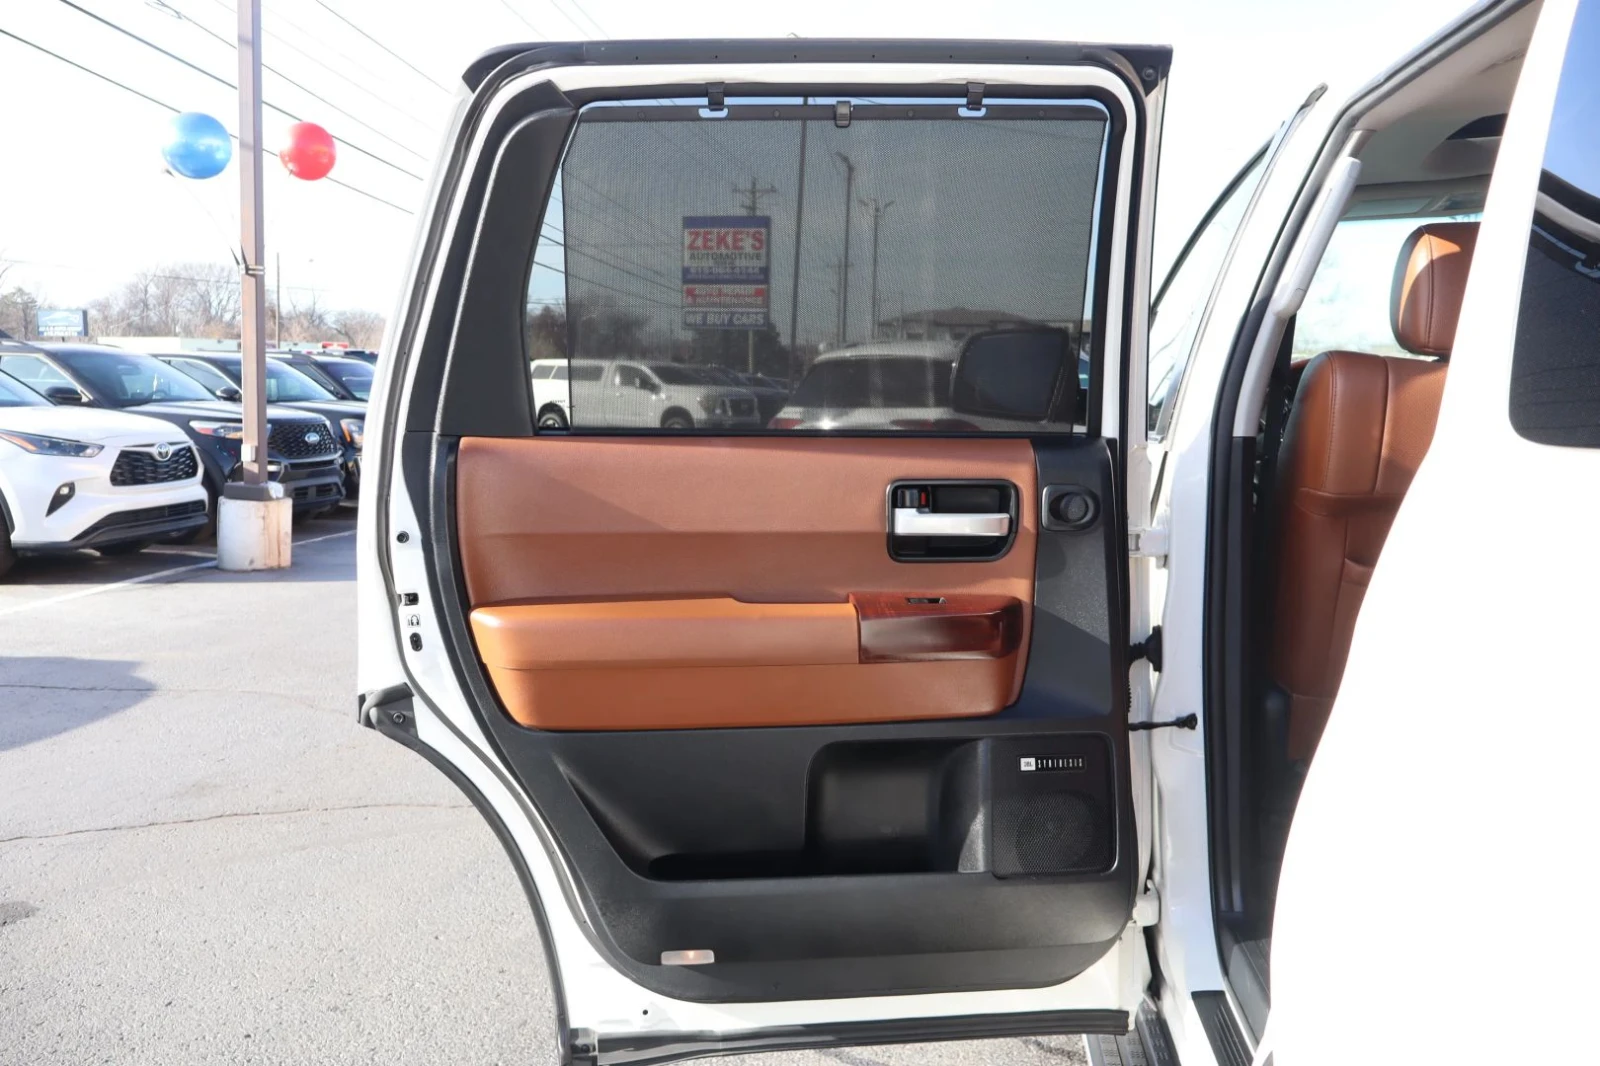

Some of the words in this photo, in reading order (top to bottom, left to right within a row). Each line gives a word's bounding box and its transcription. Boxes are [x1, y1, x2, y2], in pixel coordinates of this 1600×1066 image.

[687, 231, 764, 251] ZEKE'S
[689, 252, 762, 261] AUTOMOTIVE
[685, 313, 703, 325] WE
[706, 313, 731, 325] BUY
[733, 313, 764, 325] CARS
